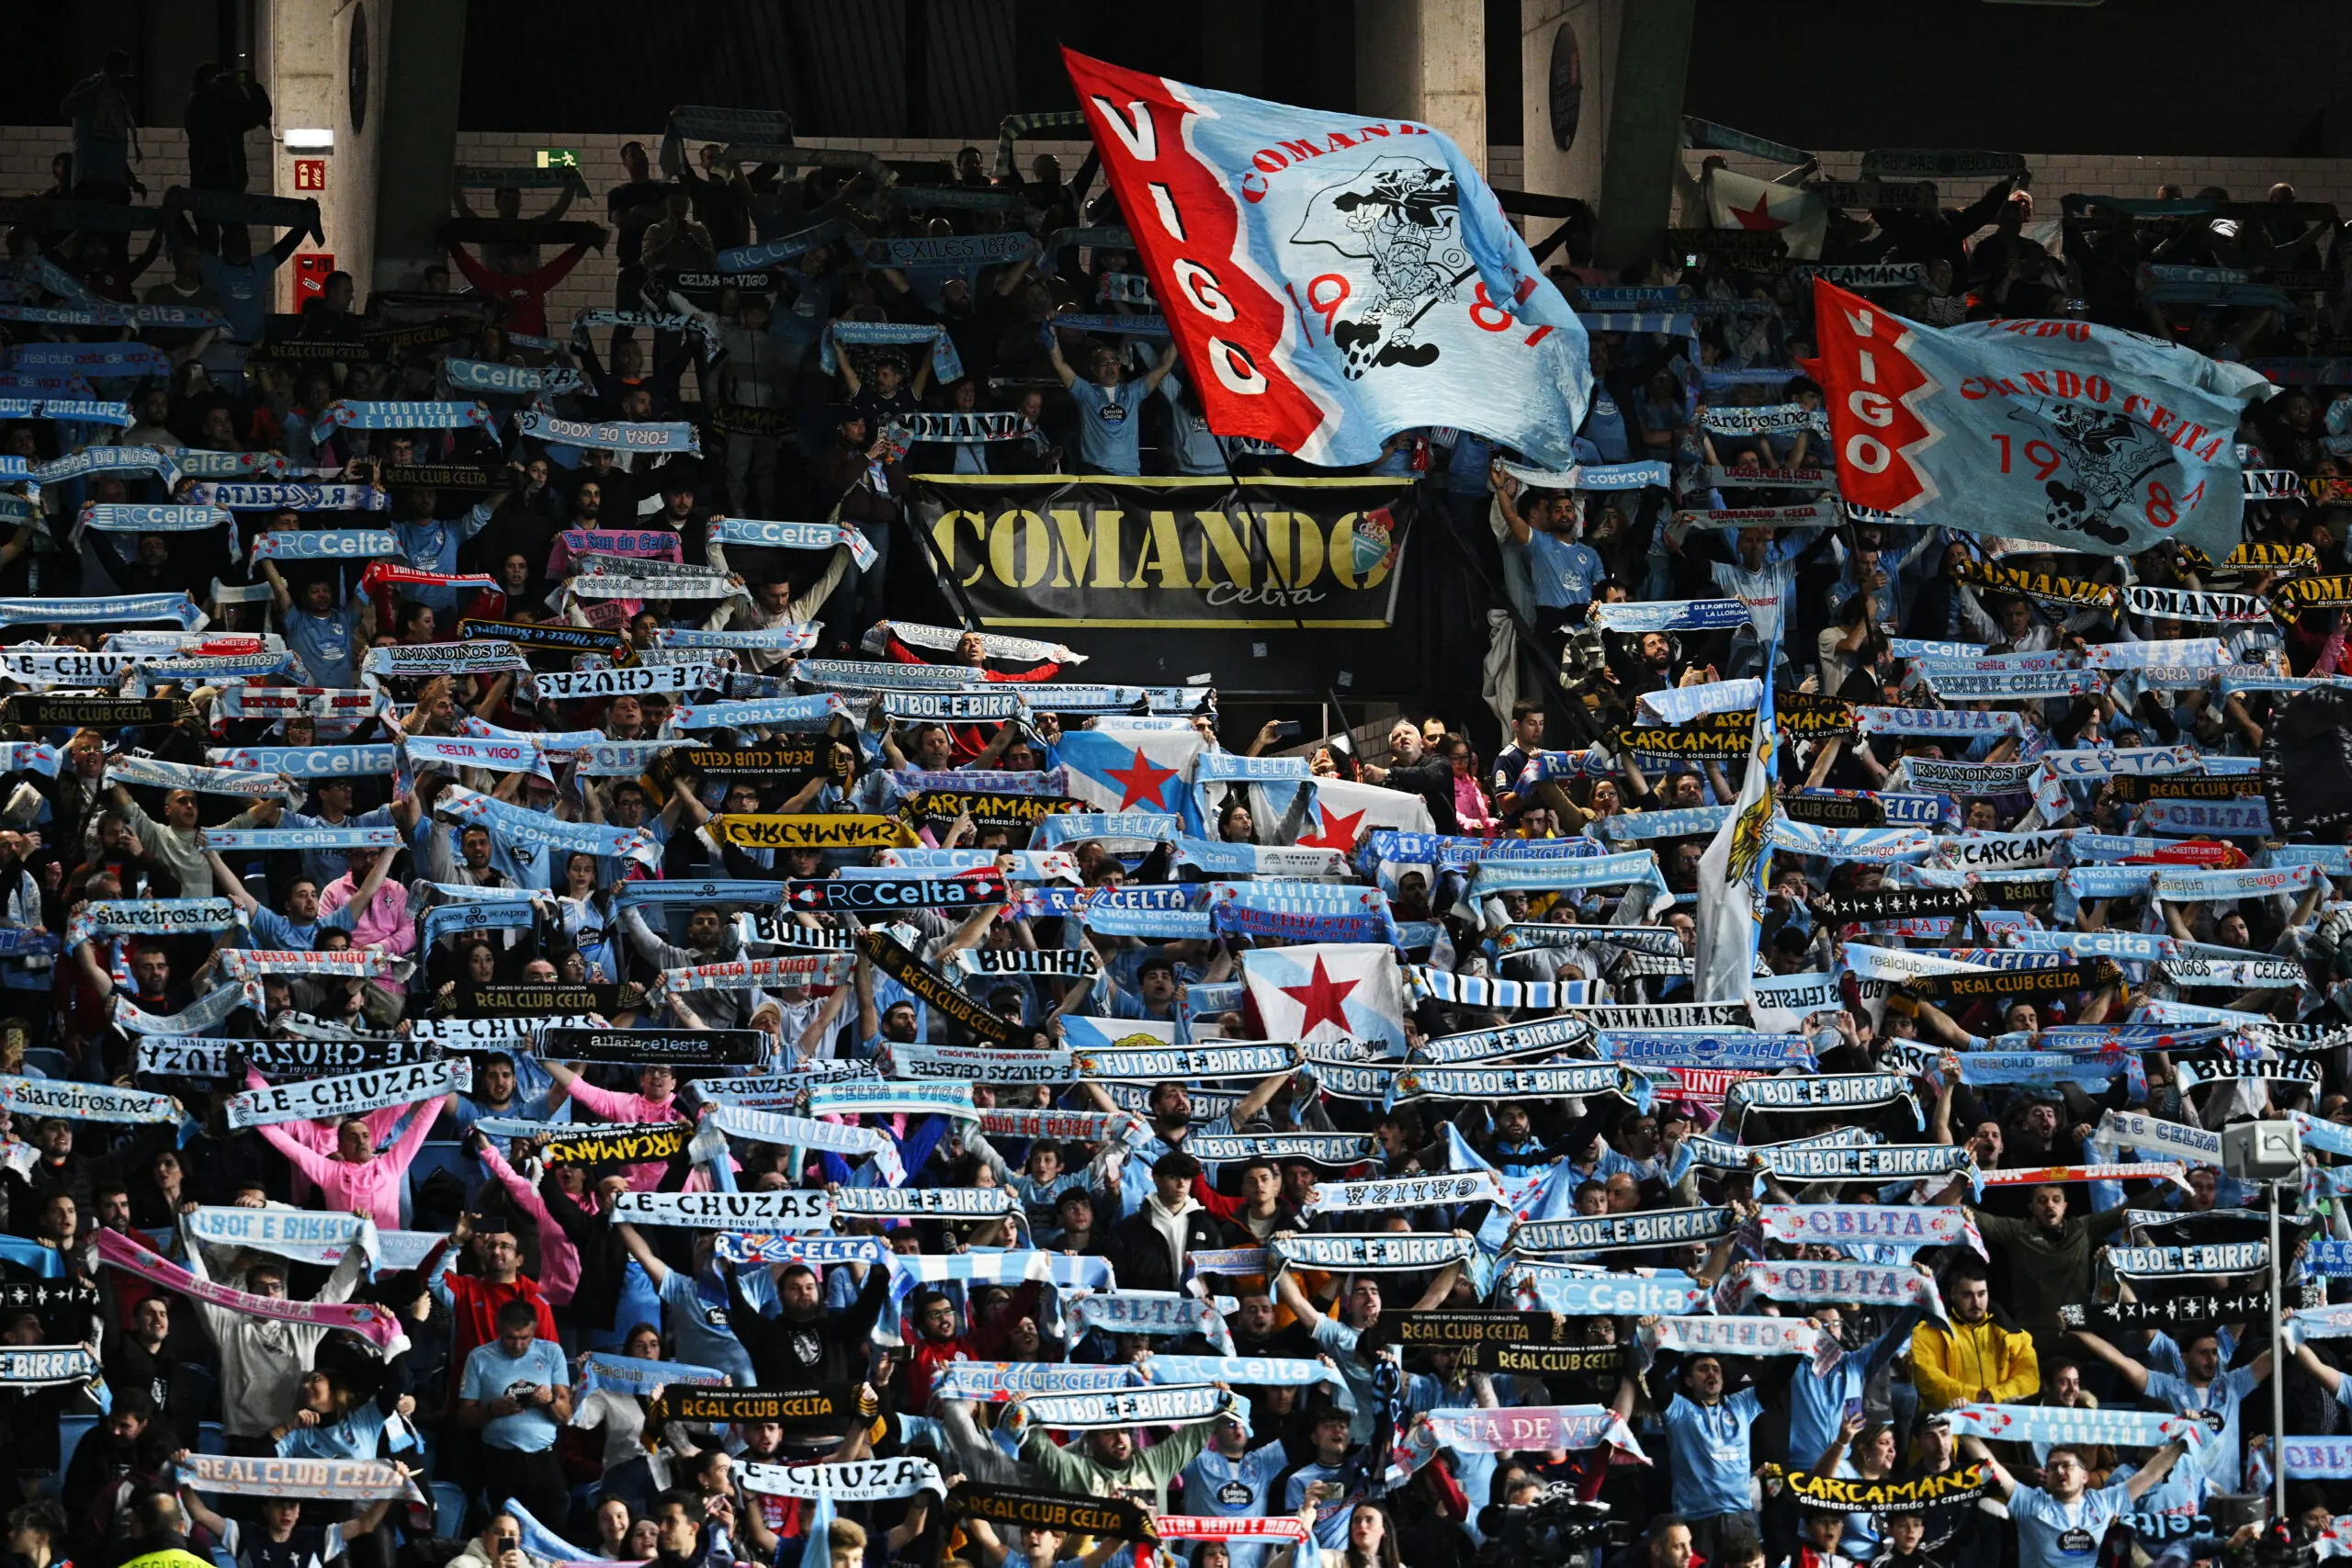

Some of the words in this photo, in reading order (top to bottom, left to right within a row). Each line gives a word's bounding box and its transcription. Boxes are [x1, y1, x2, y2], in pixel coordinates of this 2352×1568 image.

[893, 238, 974, 257] EXILES
[981, 236, 1020, 254] 1873
[1091, 95, 1269, 395] VIGO
[733, 249, 761, 267] RC
[23, 308, 91, 324] RCCelta
[24, 352, 48, 364] real
[49, 352, 74, 364] club
[107, 351, 121, 363] de
[1842, 309, 1894, 474] VIGO
[0, 400, 28, 413] DIO
[47, 400, 126, 425] GIRALDEZ
[369, 402, 454, 414] AFOUTEZA
[366, 416, 372, 427] E
[384, 412, 458, 428] CORAZÓN
[548, 420, 592, 438] XOGO
[2124, 394, 2222, 462] CELTA
[598, 428, 618, 441] DE
[627, 431, 669, 444] FORA
[1724, 467, 1757, 478] LOCOS
[1794, 469, 1822, 480] CELTA
[115, 507, 208, 524] RCCelta
[1709, 509, 1776, 520] COMANDO
[1783, 507, 1816, 518] CELTA
[279, 533, 394, 555] RCCelta
[587, 534, 614, 549] Son
[617, 536, 636, 549] do
[931, 509, 1390, 590] COMANDO
[604, 557, 670, 577] SEMPRE
[677, 565, 731, 580] CELTA
[577, 579, 631, 589] BOINAS
[645, 581, 710, 590] CELESTES
[1205, 580, 1326, 605] Celta
[2122, 587, 2265, 623] COMANDO
[1891, 640, 1984, 657] RCCelta
[537, 666, 703, 694] LE-CHUZAS
[1936, 677, 1999, 694] SEMPRE
[2011, 671, 2069, 690] CELTA
[1700, 685, 1753, 707] CELTA
[40, 706, 72, 721] REAL
[77, 706, 109, 721] CLUB
[115, 705, 153, 721] CELTA
[1895, 709, 1990, 728] CELTA
[1620, 728, 1754, 751] CARCAMÄN
[261, 750, 394, 774] RCCelta
[437, 744, 474, 757] CELTA
[487, 747, 519, 759] VIGO
[2056, 750, 2177, 773] CELTA
[2150, 781, 2189, 796] REAL
[2192, 781, 2229, 796] CLUB
[2233, 781, 2262, 796] CELT
[1790, 801, 1821, 817] CLUB
[1825, 802, 1859, 818] CELTA
[2171, 806, 2260, 824] CELTA
[1065, 818, 1093, 835] RC
[1103, 814, 1177, 835] CELTA
[1964, 839, 2060, 863] CARCAM
[827, 881, 965, 906] RCCelta
[1114, 892, 1185, 910] CELTA
[1250, 884, 1345, 898] AFOUTEZA
[1267, 897, 1351, 914] CORAZÓN
[2030, 933, 2151, 956] RCCelta
[251, 951, 299, 964] CELTA
[304, 952, 323, 963] DE
[330, 952, 367, 964] VIGO
[1951, 976, 1994, 994] REAL
[1998, 976, 2035, 992] CLUB
[2039, 972, 2080, 989] CELTA
[475, 993, 515, 1008] REAL
[518, 993, 553, 1008] CLUB
[560, 993, 596, 1008] CELTA
[901, 965, 936, 998] REAL
[936, 994, 971, 1020] CLUB
[969, 1013, 1008, 1042] CELTA
[1589, 1007, 1728, 1028] CELTARRAS
[1631, 1039, 1682, 1056] CELTA
[1733, 1039, 1782, 1058] VIGO
[1103, 1053, 1181, 1075] FUTBOL
[1190, 1051, 1203, 1073] E
[1208, 1048, 1283, 1073] BIRRAS
[989, 1066, 1070, 1080] E-CHUZAS
[1427, 1071, 1503, 1093] FUTBOL
[1516, 1070, 1530, 1091] E
[1536, 1067, 1615, 1091] BIRRAS
[253, 1063, 447, 1113] LE-CHUZAS
[2156, 1123, 2219, 1152] CELTA
[1769, 1150, 1849, 1176] FUTBOL
[1859, 1151, 1871, 1174] E
[1879, 1145, 1963, 1173] BIRRAS
[836, 1187, 910, 1212] FUTBOL
[922, 1190, 934, 1209] E
[942, 1189, 1009, 1213] BIRRA
[1346, 1179, 1477, 1205] GALIZA
[616, 1194, 821, 1218] LE-CHUZAS
[1521, 1222, 1605, 1248] FUTBOL
[1614, 1219, 1627, 1243] E
[1635, 1210, 1719, 1241] BIRRAS
[1810, 1211, 1925, 1235] CELTA
[715, 1235, 763, 1258] R.C.
[789, 1238, 878, 1259] CELTA
[1278, 1239, 1355, 1263] FUTBOL
[1366, 1238, 1379, 1262] E
[1386, 1236, 1472, 1263] BIRRAS
[1785, 1267, 1897, 1295] CELTA
[1541, 1281, 1682, 1304] RCCelta
[1402, 1322, 1441, 1339] REAL
[1443, 1323, 1483, 1339] CLUB
[1487, 1323, 1529, 1341] CELTA
[1173, 1360, 1310, 1382] RCCelta
[682, 1399, 729, 1417] REAL
[733, 1400, 779, 1416] CLUB
[782, 1398, 832, 1416] CELTA
[1031, 1395, 1108, 1422] FUTBOL
[1118, 1393, 1131, 1416] E
[1138, 1389, 1216, 1415] BIRRAS
[2029, 1407, 2142, 1426] AFOUTEZA
[1513, 1416, 1552, 1440] DE
[2023, 1425, 2030, 1440] E
[2043, 1422, 2148, 1443] CORAZÓN
[194, 1458, 258, 1482] REAL
[265, 1461, 327, 1485] CLUB
[334, 1465, 403, 1487] CELTA
[969, 1496, 1018, 1518] REAL
[1021, 1504, 1067, 1524] CLUB
[1069, 1508, 1122, 1530] CELTA
[130, 1557, 204, 1568] SEGURI
